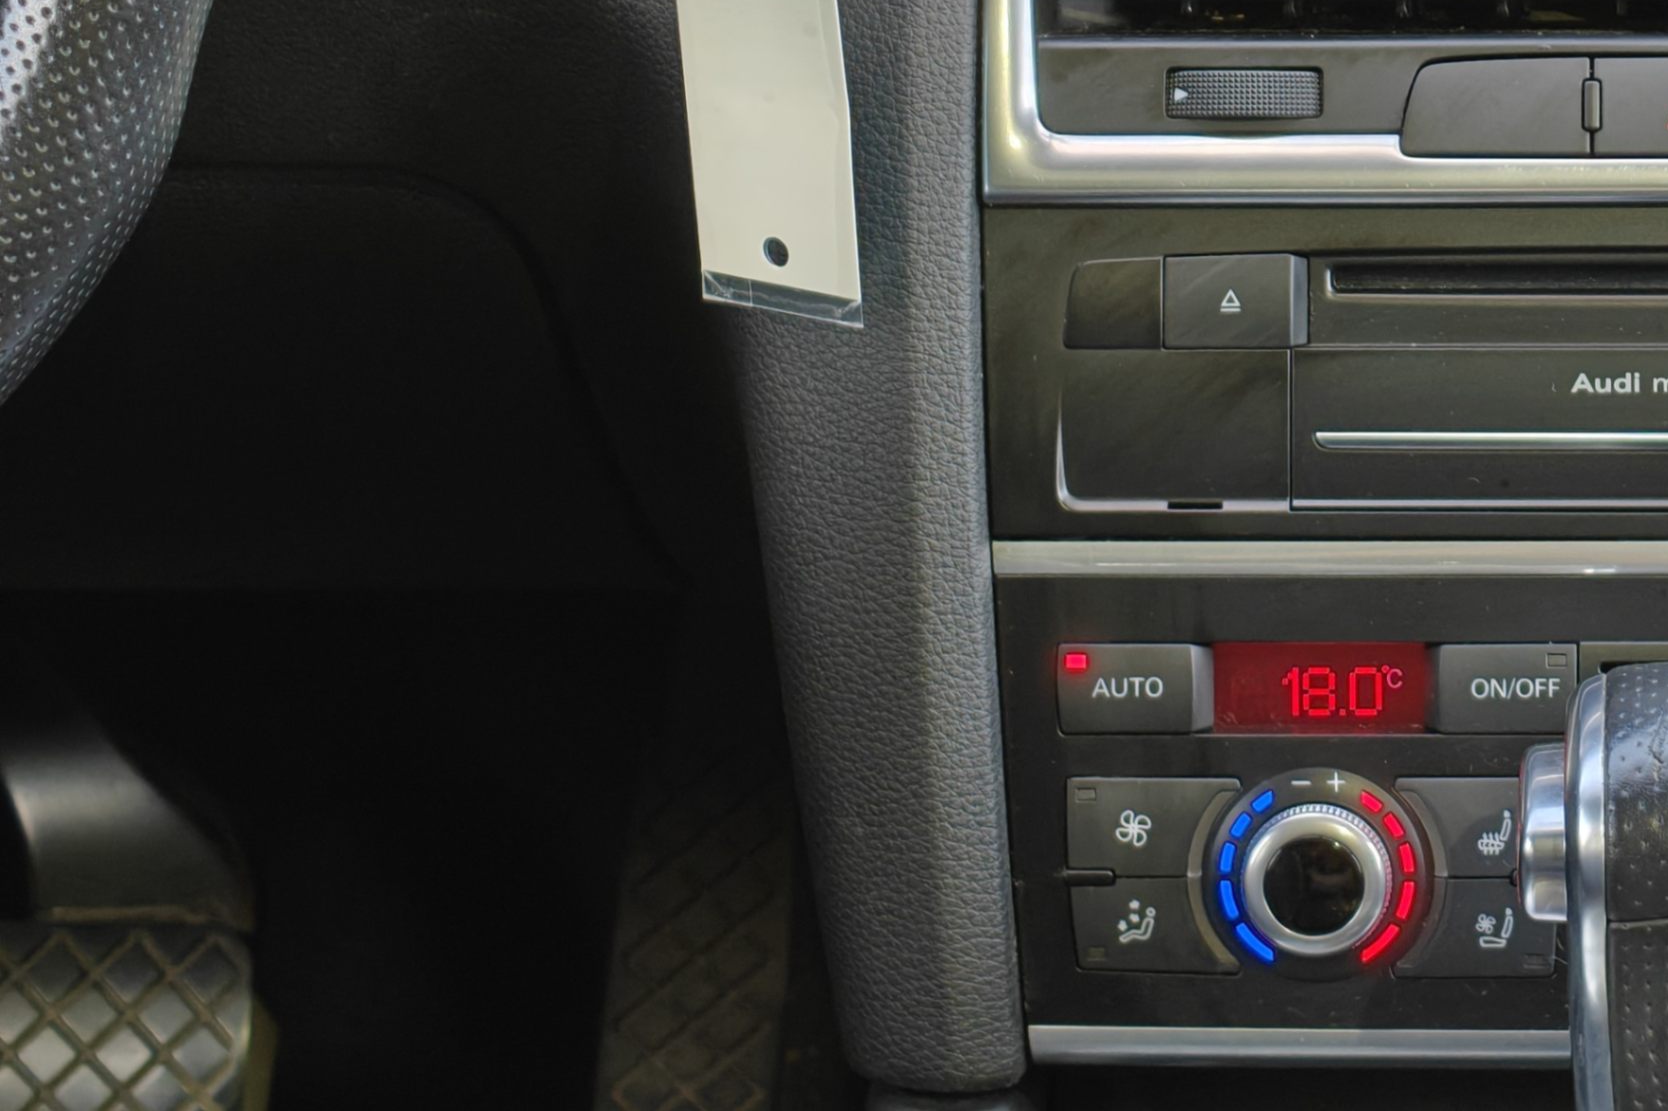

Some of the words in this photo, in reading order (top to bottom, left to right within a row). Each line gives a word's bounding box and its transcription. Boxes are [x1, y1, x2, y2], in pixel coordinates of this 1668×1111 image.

[1570, 372, 1641, 393] Audi
[1092, 676, 1164, 699] AUTO
[1470, 677, 1561, 700] ON/OFF
